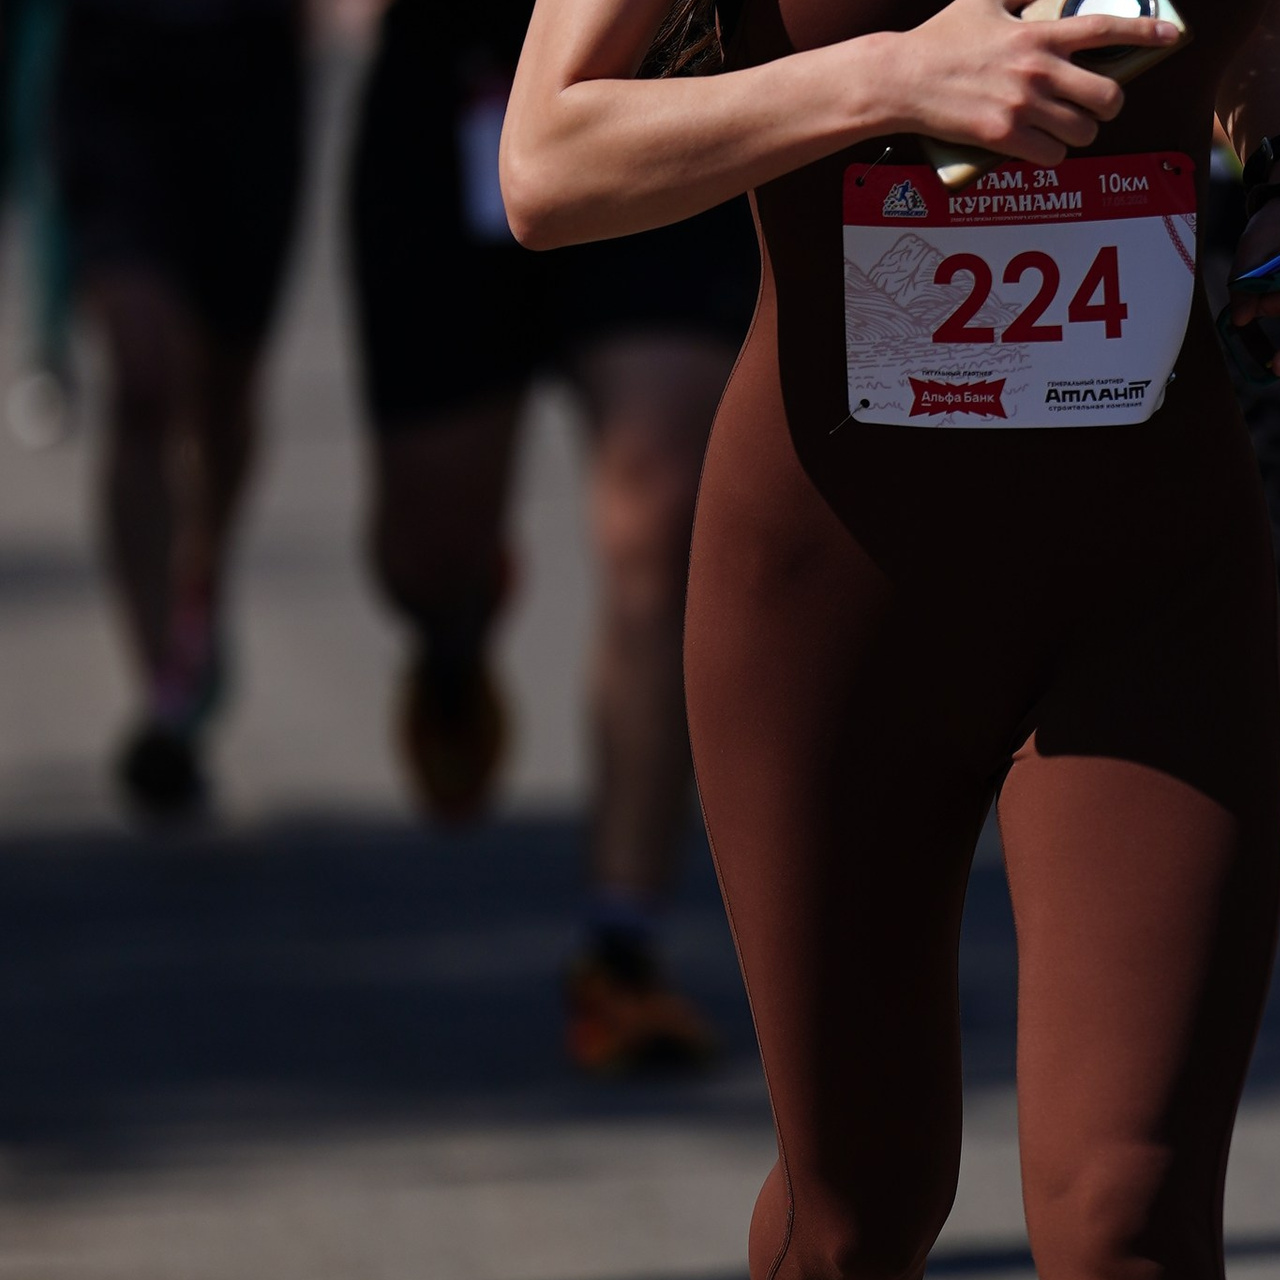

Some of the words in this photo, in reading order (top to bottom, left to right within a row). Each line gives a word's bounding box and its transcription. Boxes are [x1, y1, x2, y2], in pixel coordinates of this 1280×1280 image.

[1032, 169, 1059, 188] ЗА
[948, 190, 1083, 215] КУРГАНАМИ
[932, 245, 1128, 344] 224
[1047, 379, 1095, 387] ГЕНЕРАЛЬНЫЙ
[921, 390, 962, 405] Альфа
[963, 391, 995, 403] Банк
[1048, 403, 1105, 412] строительная
[1106, 401, 1142, 409] компания
